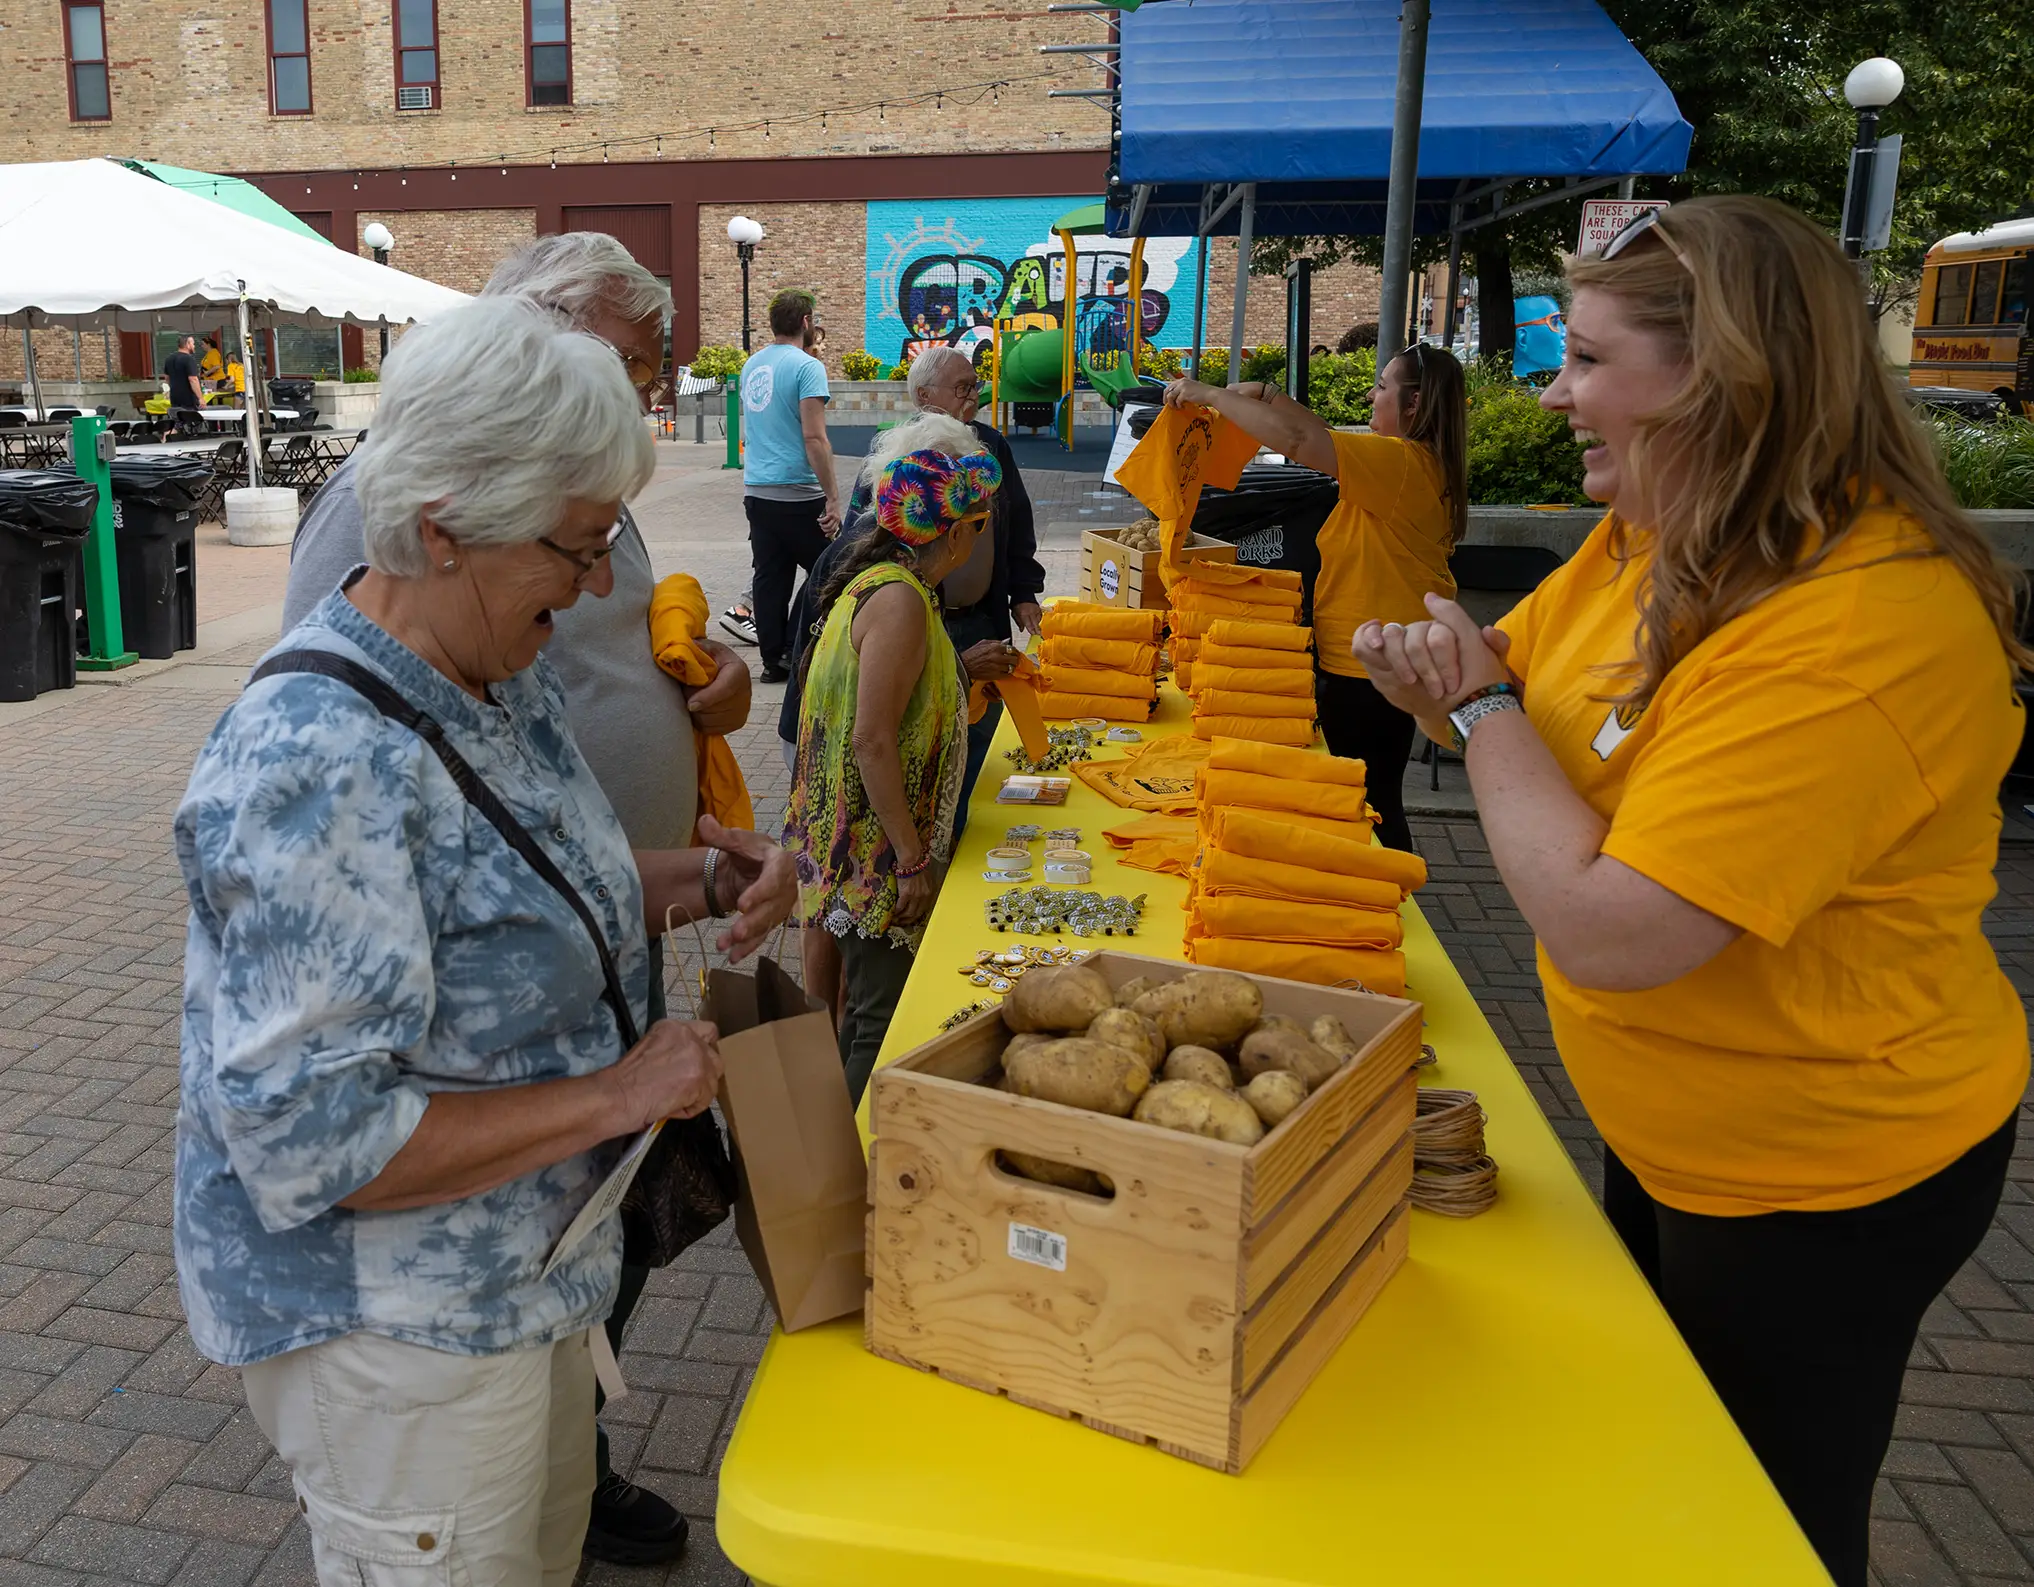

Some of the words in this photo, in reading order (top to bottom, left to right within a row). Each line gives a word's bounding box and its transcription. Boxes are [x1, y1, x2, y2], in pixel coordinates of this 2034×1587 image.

[1594, 205, 1623, 216] THESE
[1586, 217, 1605, 228] ARE
[1232, 527, 1284, 547] RAND
[1237, 544, 1284, 564] ORKS
[1100, 564, 1121, 584] Locally
[1100, 578, 1119, 595] Grown
